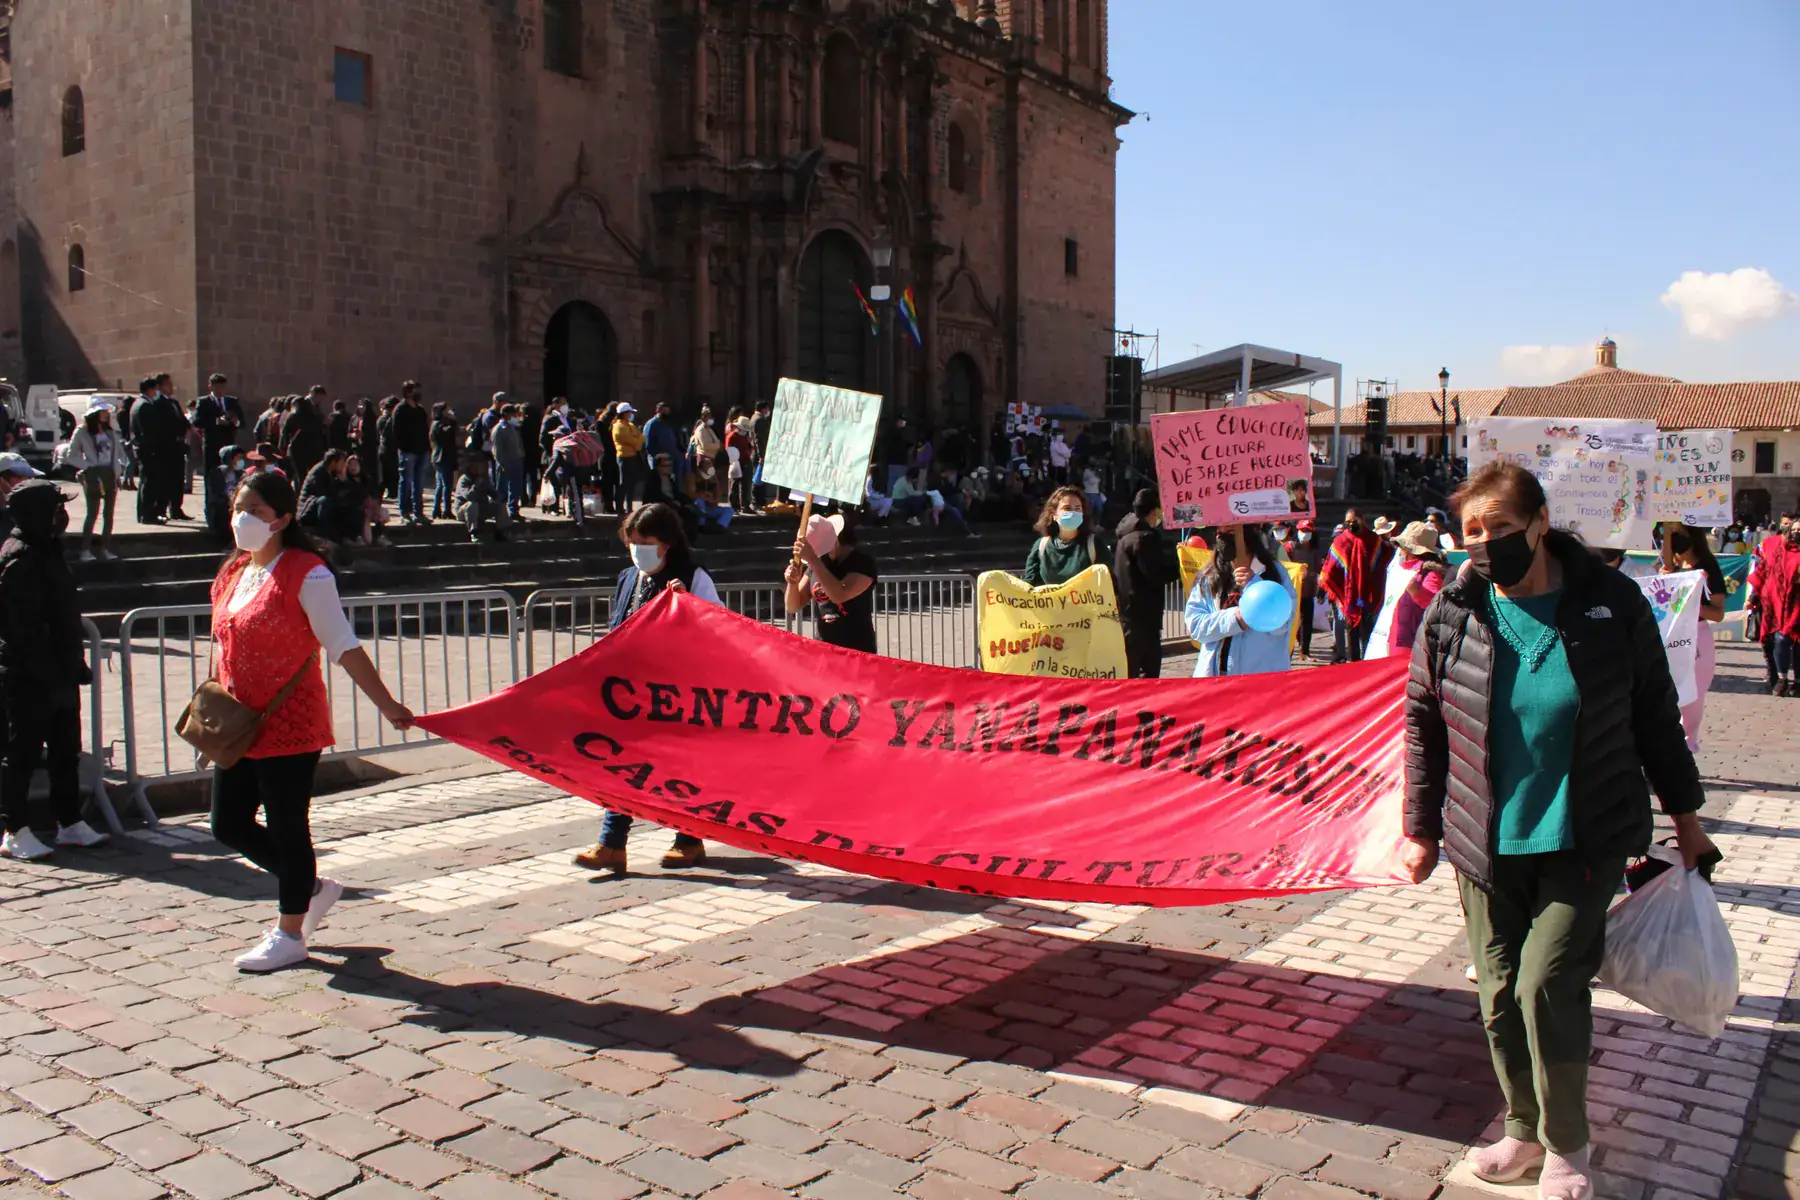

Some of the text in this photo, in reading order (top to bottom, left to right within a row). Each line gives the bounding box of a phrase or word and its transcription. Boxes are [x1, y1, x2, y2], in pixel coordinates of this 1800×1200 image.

[1161, 421, 1206, 459] DAME
[1201, 440, 1266, 461] CULTURA
[1681, 448, 1702, 461] ES
[1589, 458, 1604, 471] hoy
[1694, 460, 1720, 473] UN
[1171, 461, 1240, 487] DEJARE
[1677, 474, 1731, 486] DERECHO
[1177, 474, 1286, 503] EN LA SOCIEDAD
[1031, 659, 1045, 672] en
[1048, 657, 1058, 672] la
[601, 676, 861, 739] CENTRO
